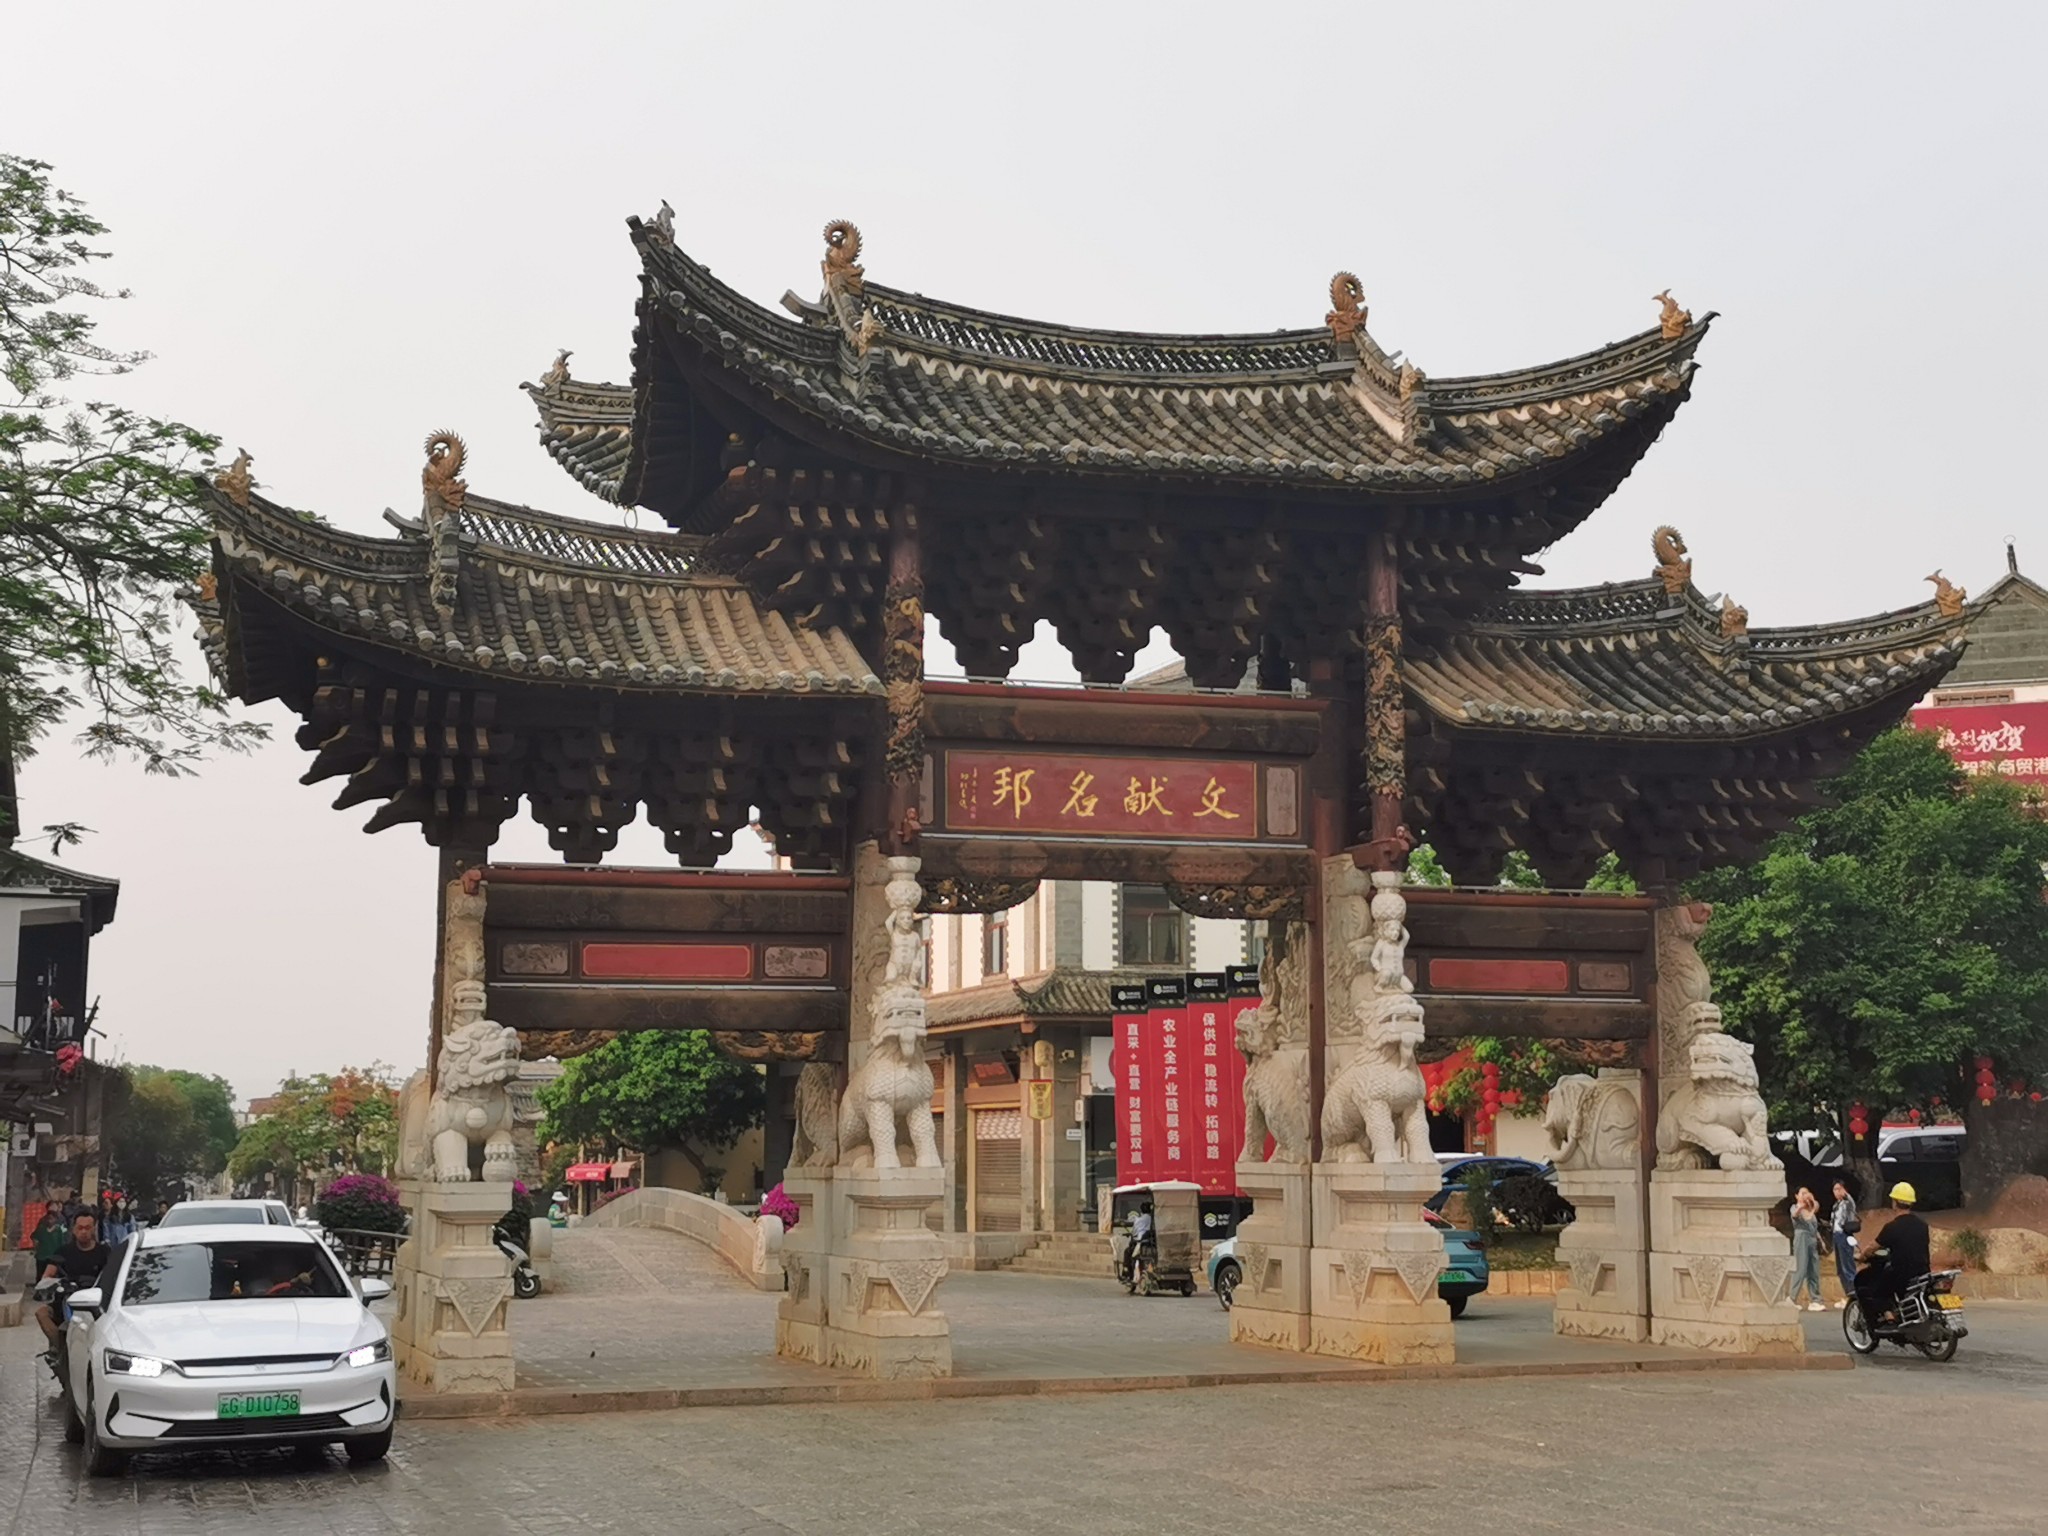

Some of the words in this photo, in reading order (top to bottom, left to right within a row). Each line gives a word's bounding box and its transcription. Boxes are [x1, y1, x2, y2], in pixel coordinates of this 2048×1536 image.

[1937, 721, 2026, 753] 热烈祝贺
[1953, 757, 2048, 776] 智慧商贸港
[992, 766, 1240, 820] 文献名邦
[1203, 1012, 1217, 1057] 保供应
[1163, 1018, 1181, 1160] 农业全产业链服务商
[1204, 1063, 1218, 1108] 稳流转
[1206, 1114, 1220, 1160] 拓销路
